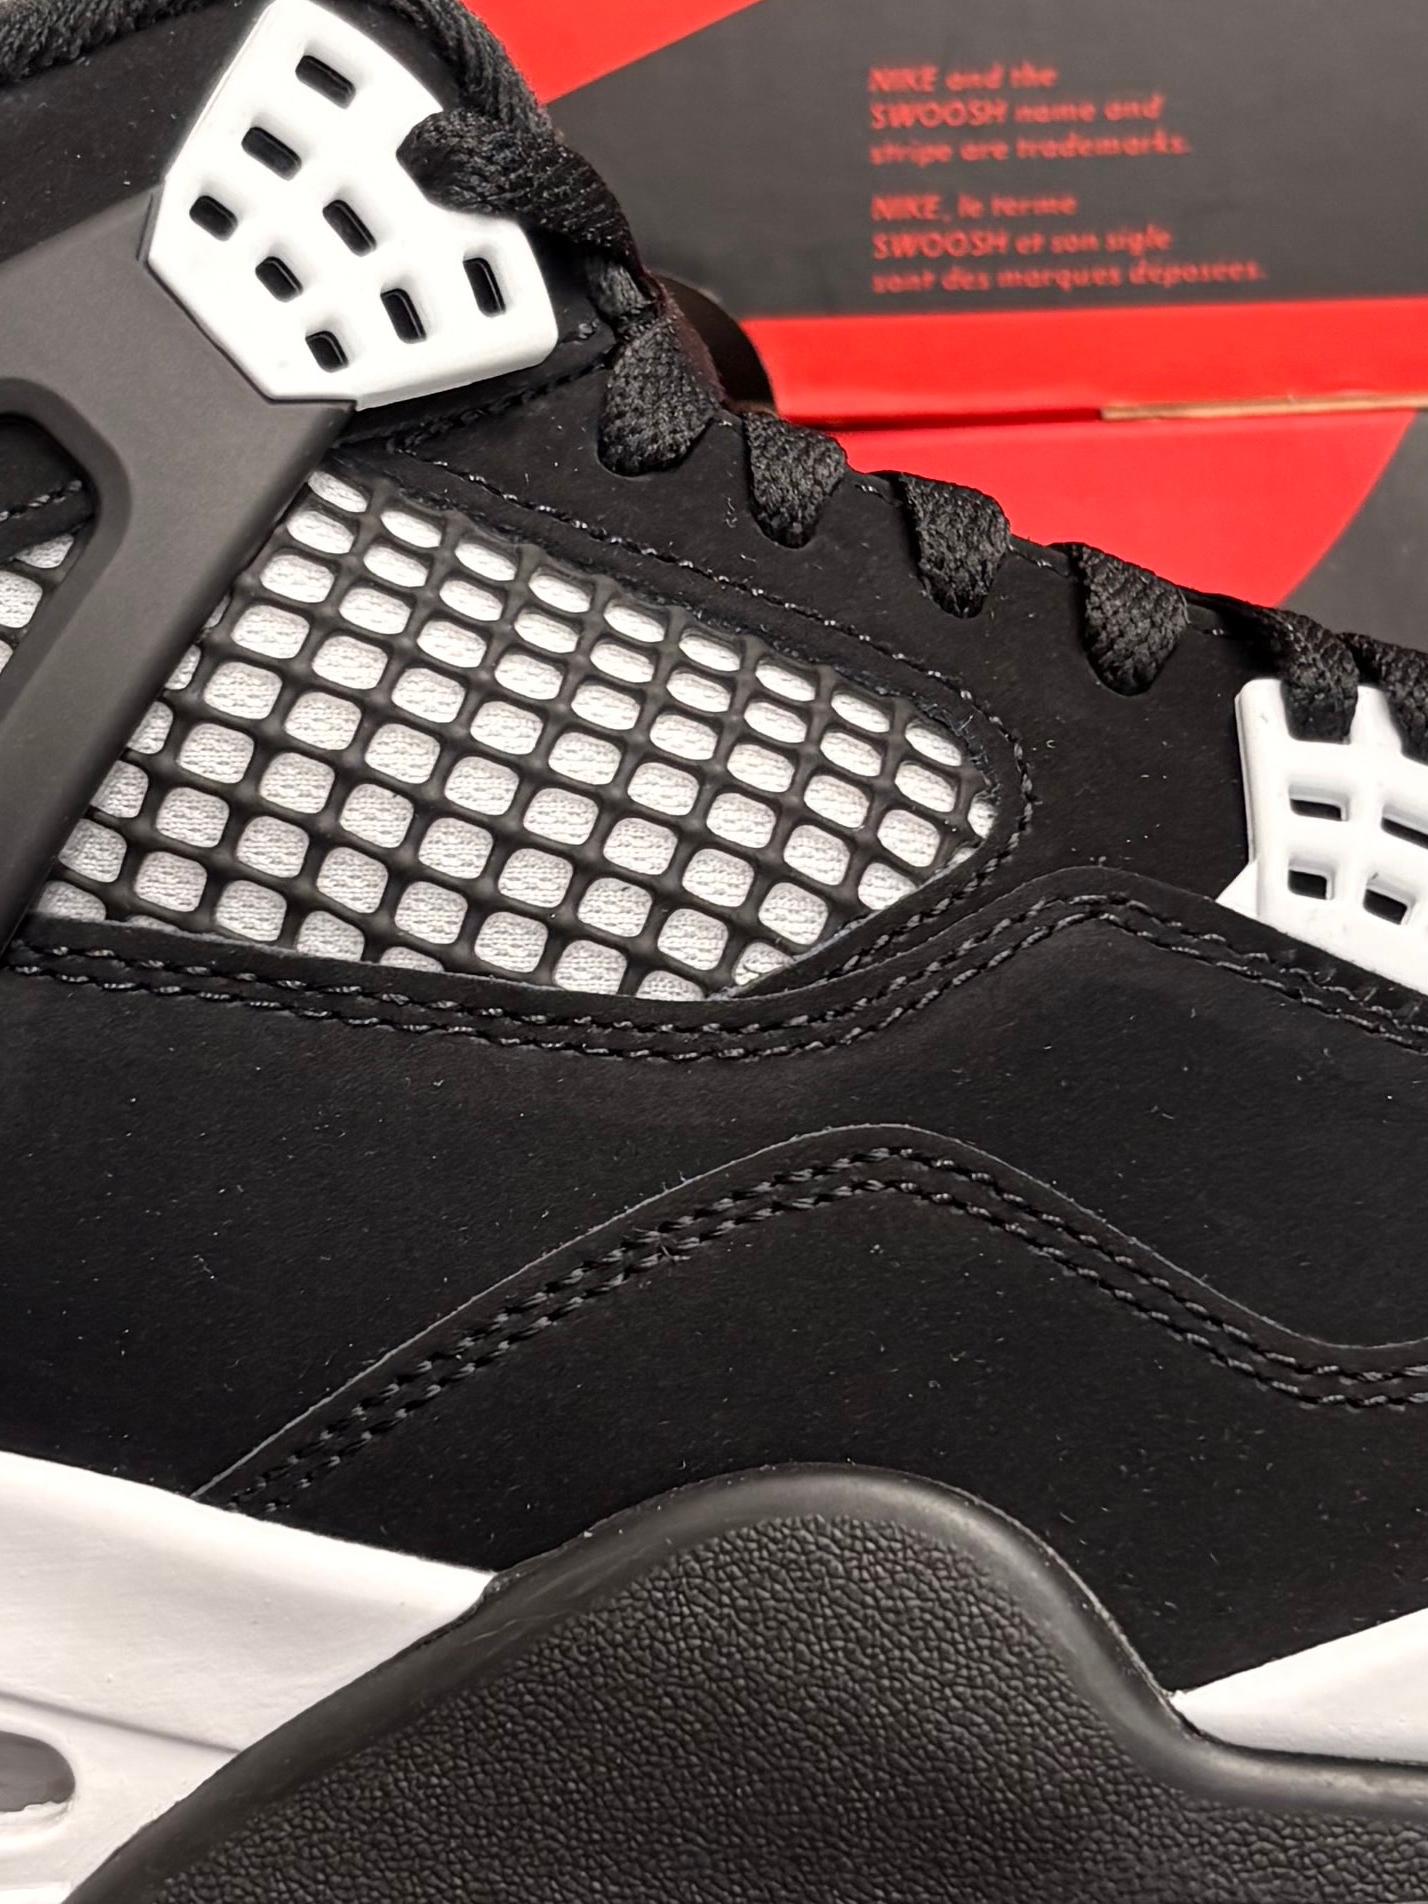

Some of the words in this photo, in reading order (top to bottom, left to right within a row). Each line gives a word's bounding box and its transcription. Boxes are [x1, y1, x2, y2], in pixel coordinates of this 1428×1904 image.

[869, 63, 936, 93] NIKE
[944, 61, 1004, 92] and
[1009, 60, 1058, 88] the
[870, 97, 1009, 130] SWOOSH
[1014, 102, 1096, 123] name
[1103, 90, 1164, 122] and
[869, 138, 953, 168] stripe
[959, 141, 1009, 161] are
[1015, 128, 1192, 161] trademarks.
[871, 192, 952, 224] NIKE,
[957, 192, 983, 219] le
[990, 193, 1079, 217] terme
[872, 229, 1009, 261] SWOOSH
[1014, 232, 1044, 255] et
[1050, 232, 1100, 255] son
[1104, 223, 1173, 257] sigle
[872, 269, 936, 295] sont
[940, 264, 990, 292] des
[995, 266, 1121, 294] marques
